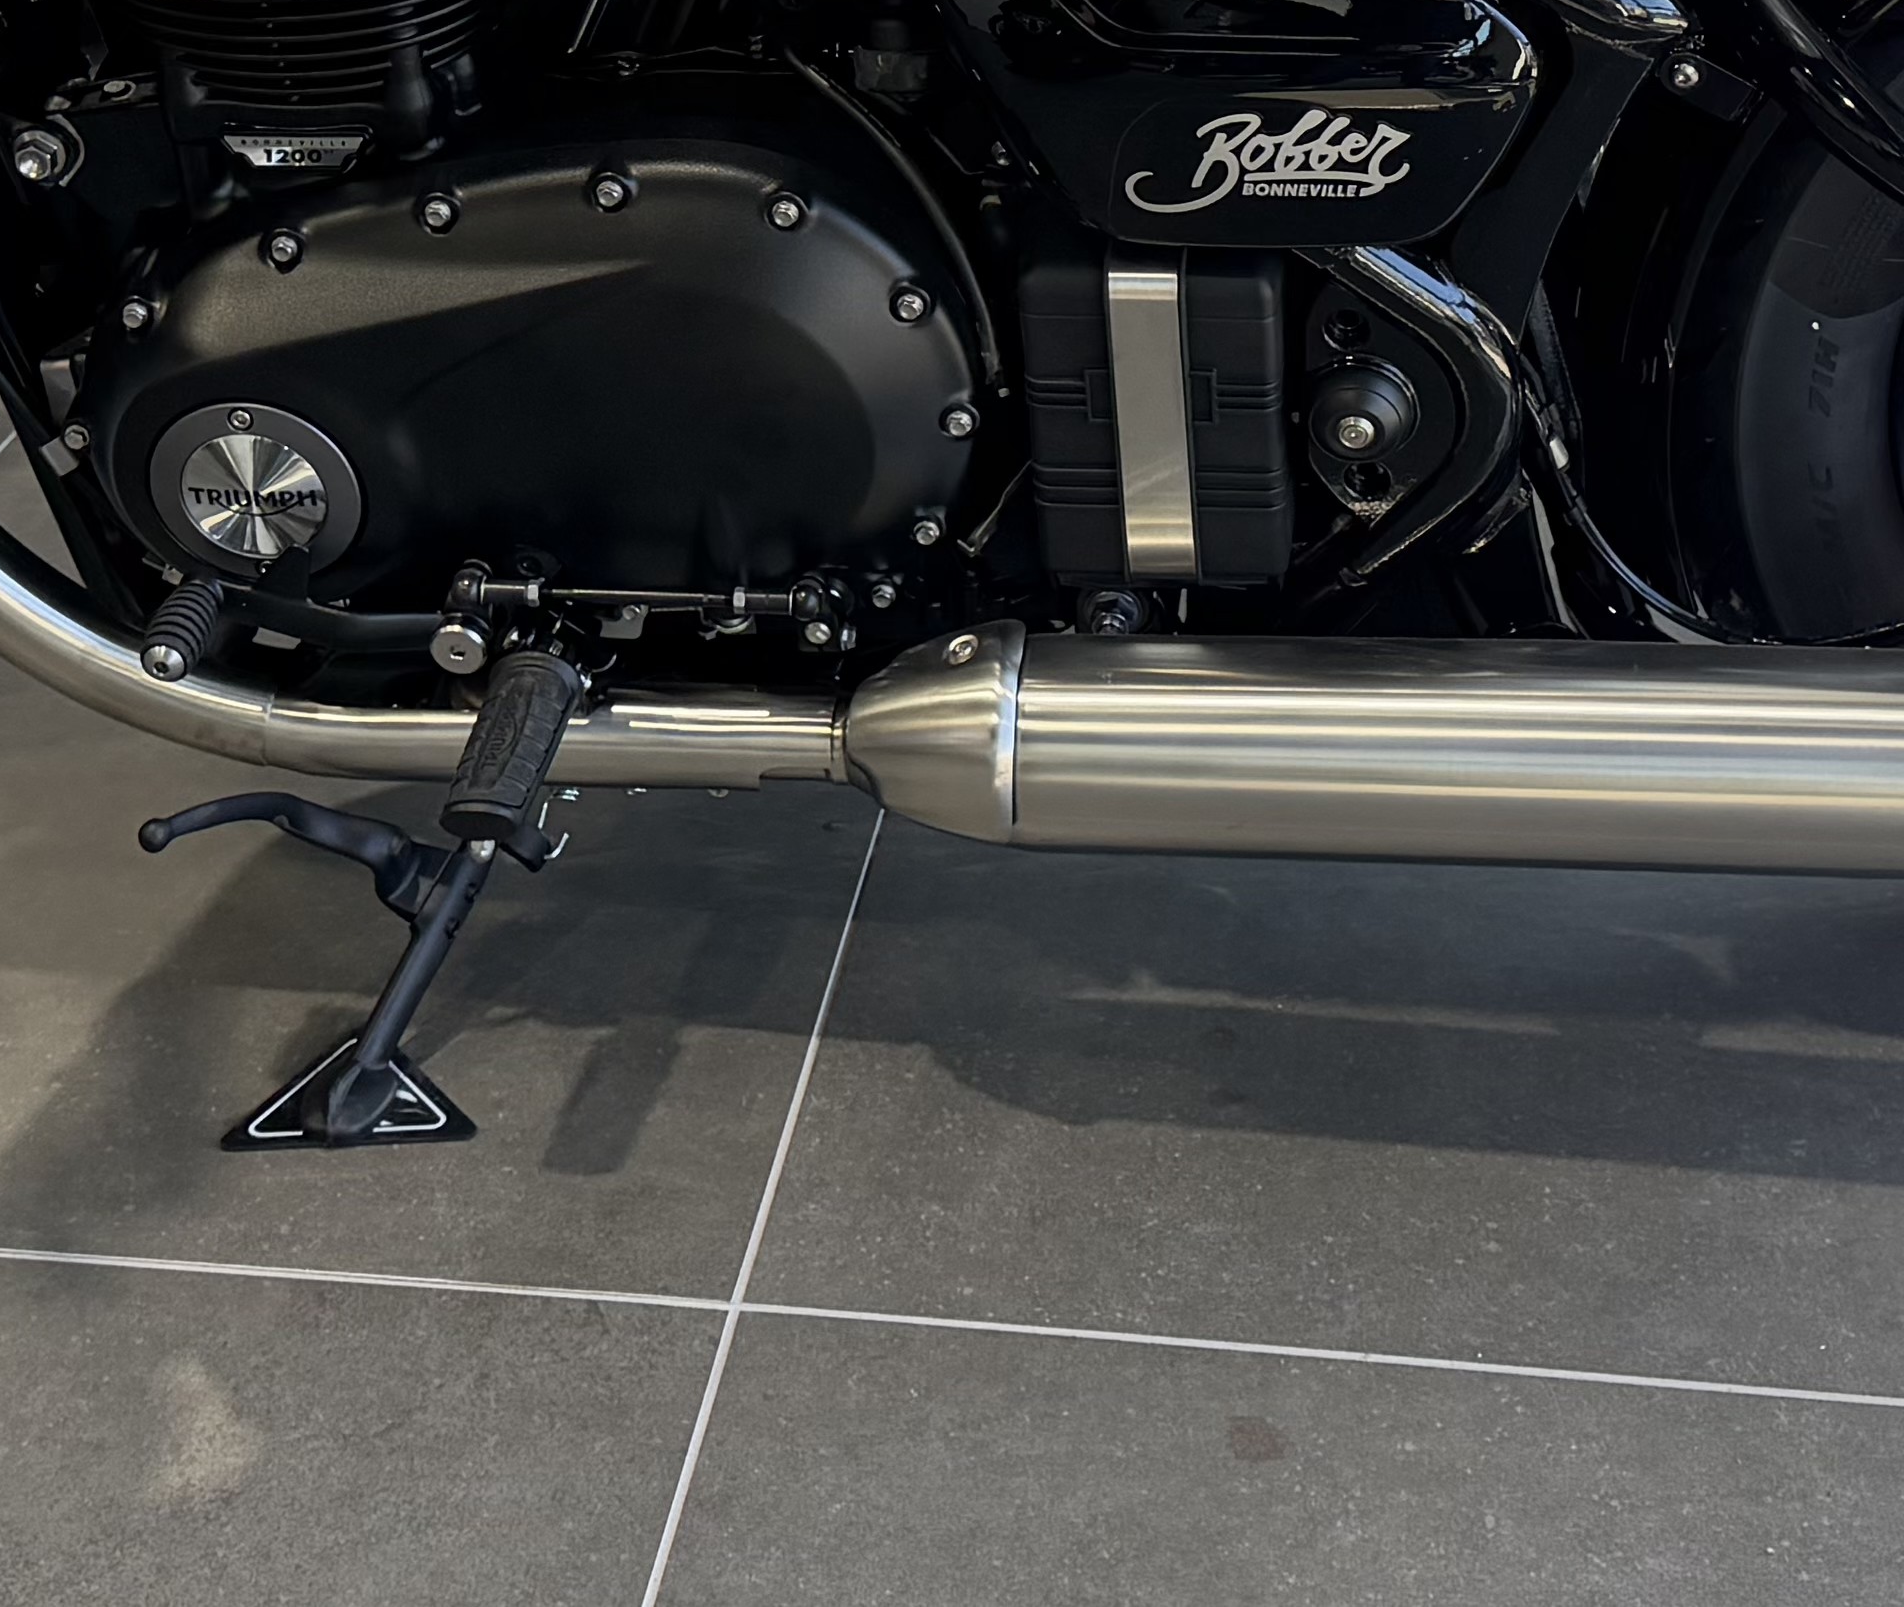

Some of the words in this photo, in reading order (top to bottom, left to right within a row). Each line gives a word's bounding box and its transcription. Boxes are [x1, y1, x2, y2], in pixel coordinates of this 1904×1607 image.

[263, 148, 323, 165] 1200
[1125, 109, 1411, 213] Bobber
[1242, 182, 1358, 198] BONNEVILLE
[1807, 335, 1841, 418] 71H
[187, 486, 318, 517] TRIUMPH
